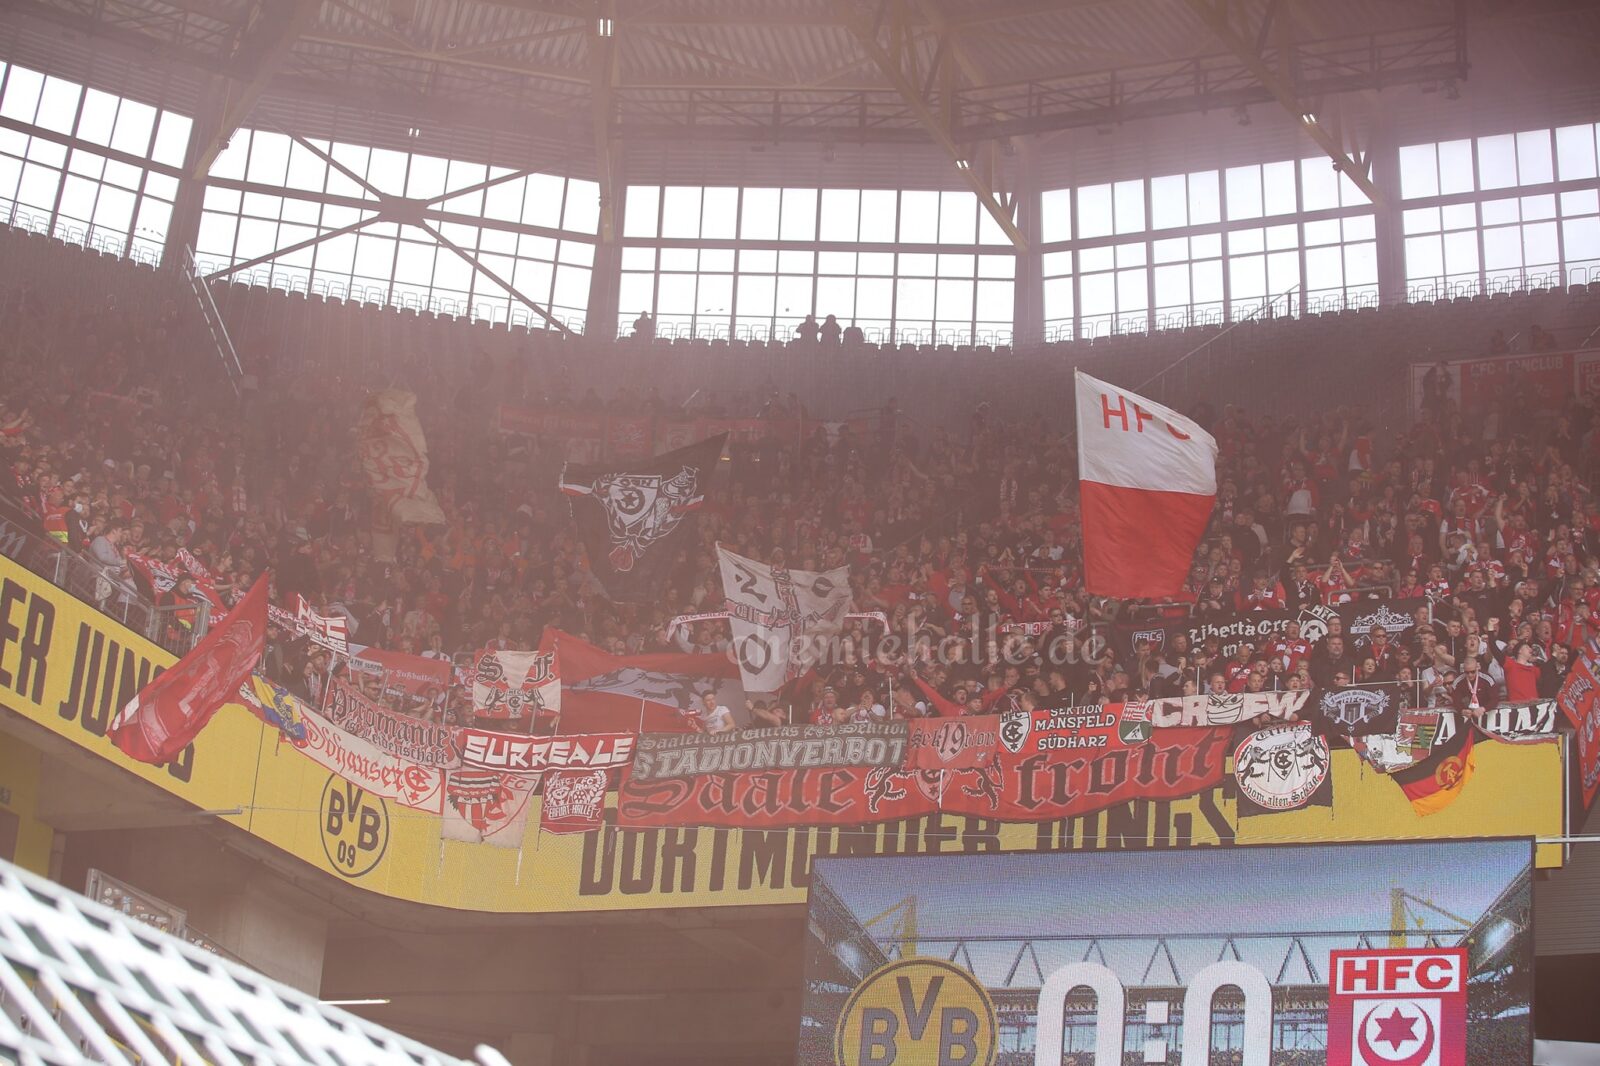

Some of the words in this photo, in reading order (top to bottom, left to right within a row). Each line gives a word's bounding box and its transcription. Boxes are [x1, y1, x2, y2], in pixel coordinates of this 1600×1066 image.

[1257, 617, 1303, 637] Cre
[59, 621, 195, 784] JUN
[329, 688, 449, 749] Pyromanie
[1050, 704, 1103, 717] SEKTION
[1034, 714, 1116, 732] MANSFELD
[463, 734, 634, 768] SURREALE
[631, 736, 908, 780] STADIONVERBOT
[1037, 734, 1108, 750] SÜDHARZ
[621, 767, 858, 819] Saale
[1013, 727, 1232, 812] front
[327, 780, 382, 852] BVB
[337, 838, 357, 868] 09
[1342, 956, 1456, 991] HFC
[858, 976, 978, 1066] BVB
